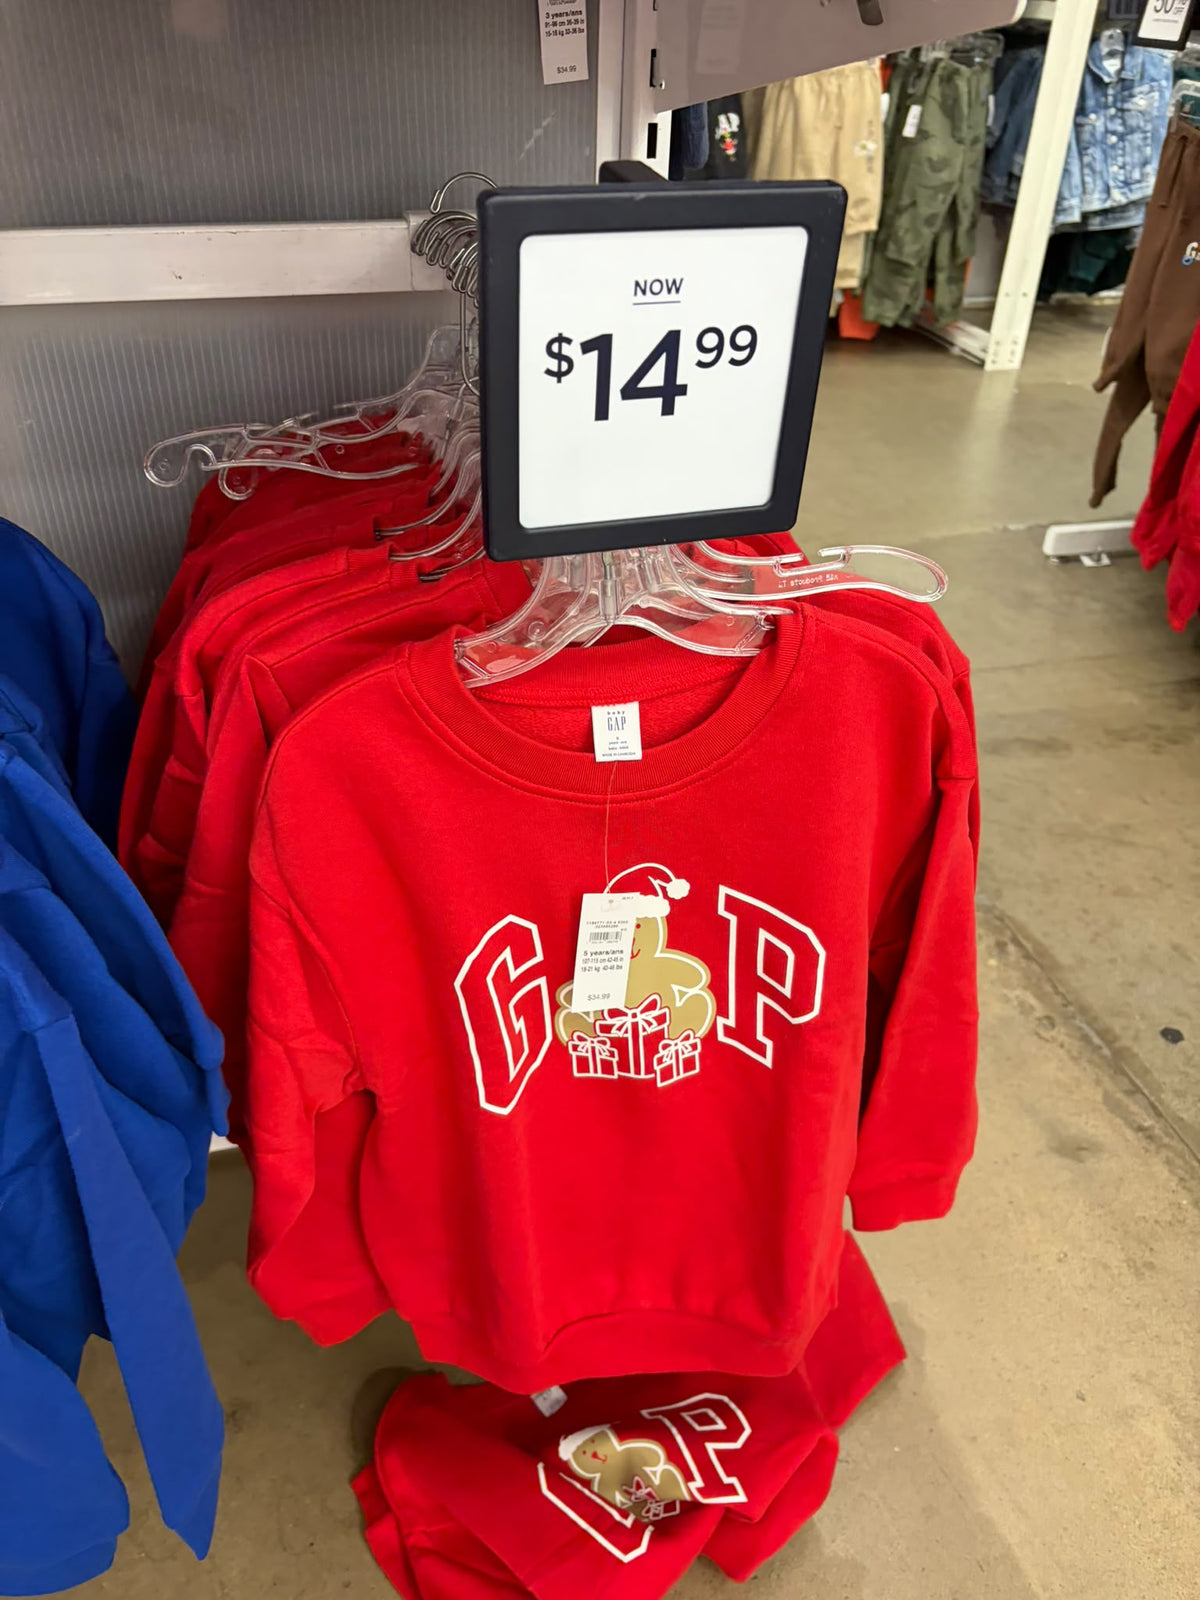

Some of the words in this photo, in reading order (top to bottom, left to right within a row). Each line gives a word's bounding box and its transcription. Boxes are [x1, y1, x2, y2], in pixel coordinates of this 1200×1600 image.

[551, 9, 583, 20] years/ans
[558, 29, 564, 37] kg
[557, 65, 577, 74] $34.99
[633, 277, 684, 297] NOW
[607, 716, 626, 731] GAP
[589, 949, 624, 957] years/ans
[594, 965, 601, 973] kg
[587, 992, 611, 1001] $34.99
